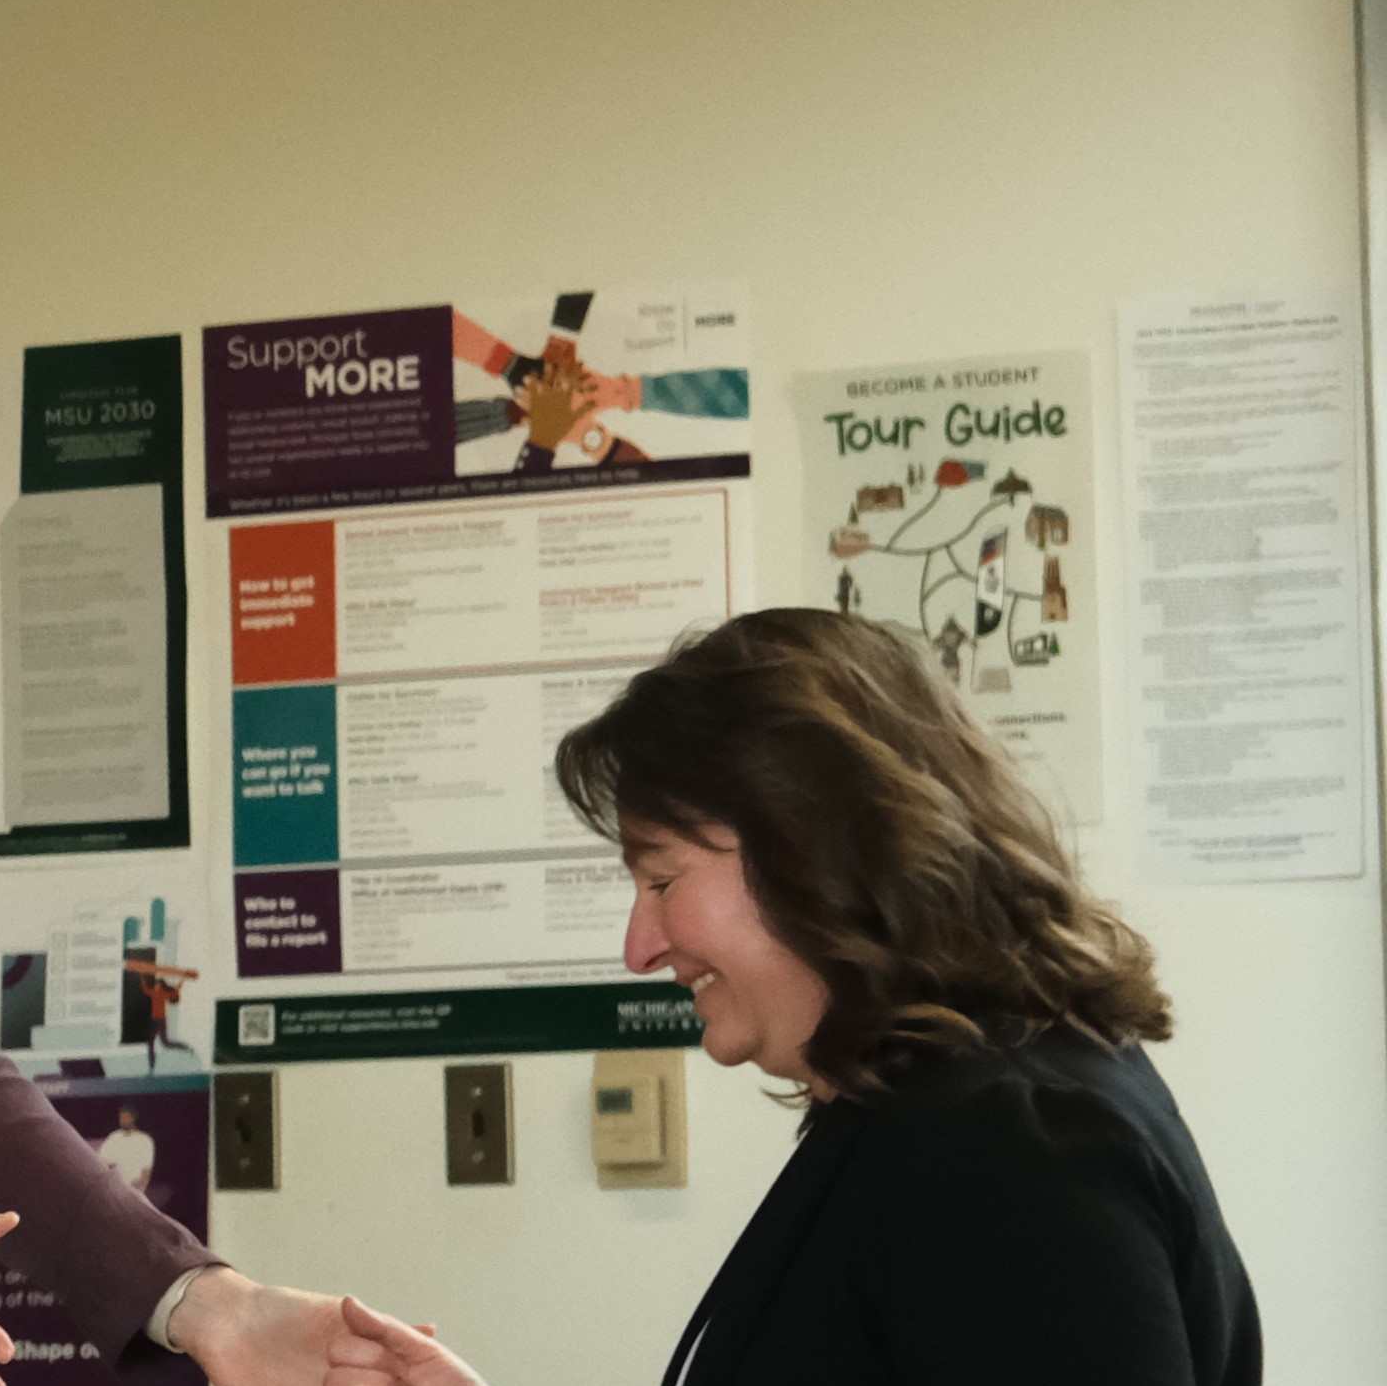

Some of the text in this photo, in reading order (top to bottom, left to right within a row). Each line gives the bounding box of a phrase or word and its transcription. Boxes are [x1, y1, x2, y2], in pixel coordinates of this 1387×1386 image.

[227, 328, 368, 371] Support
[305, 354, 421, 398] MORE
[846, 366, 1039, 399] BECOME A STUDENT
[45, 399, 156, 426] MSU 2030
[824, 398, 1068, 456] Tour Guide
[5, 1289, 24, 1307] of
[26, 1290, 54, 1306] the
